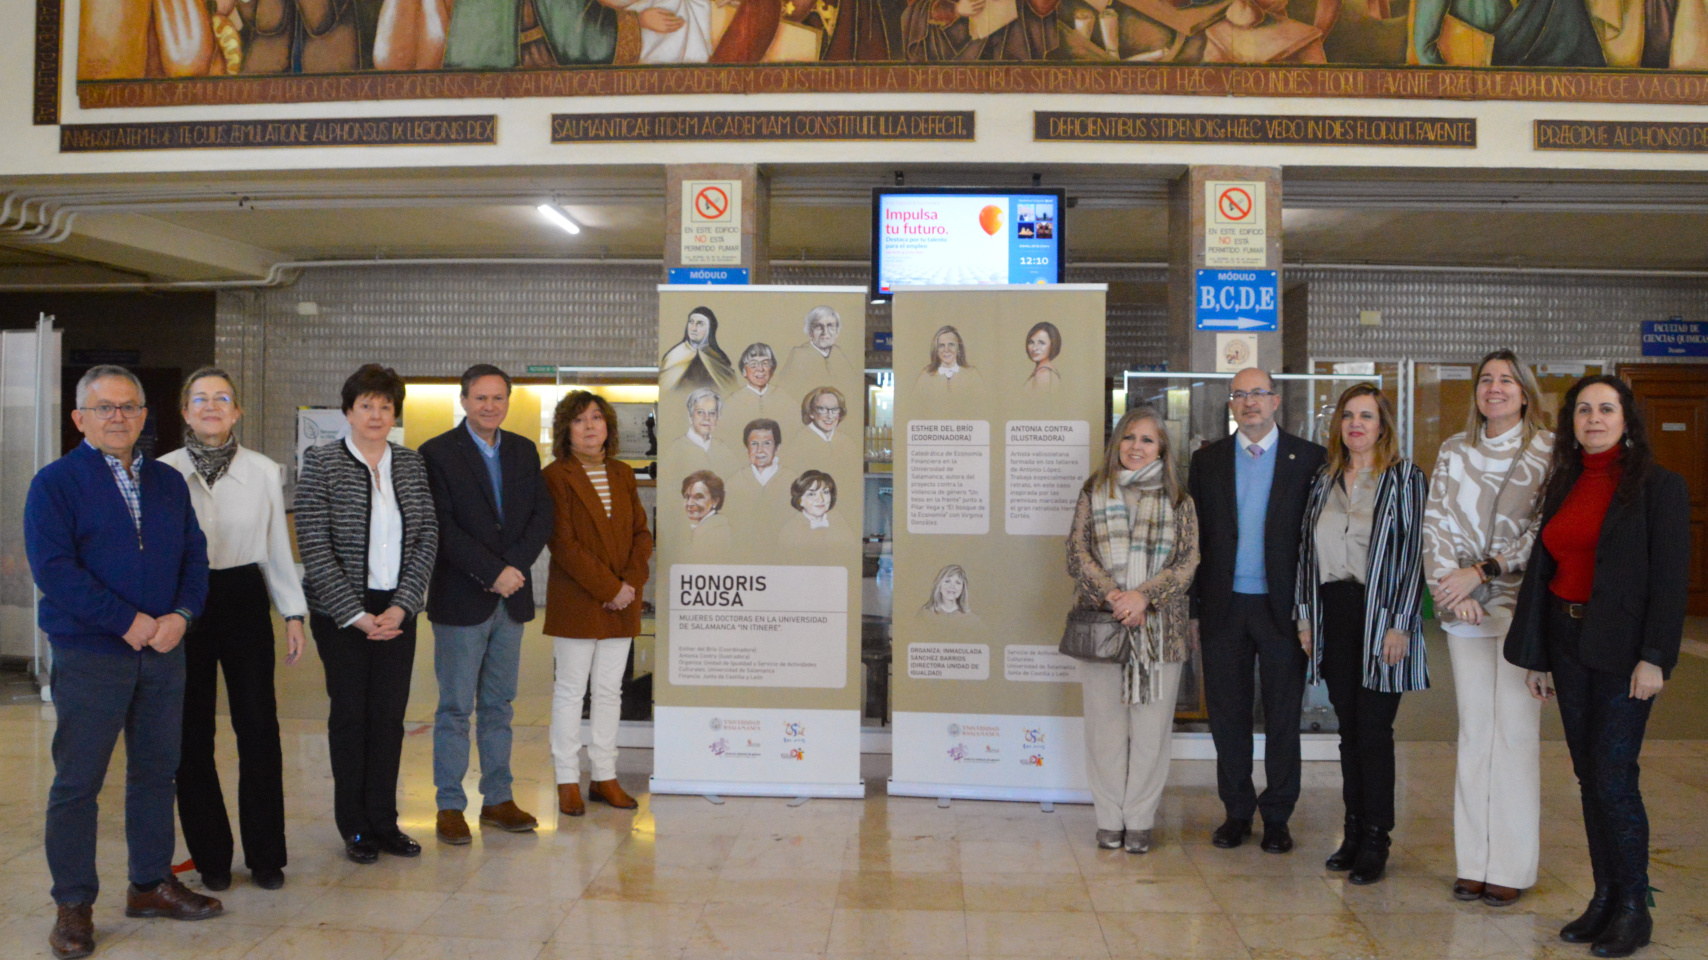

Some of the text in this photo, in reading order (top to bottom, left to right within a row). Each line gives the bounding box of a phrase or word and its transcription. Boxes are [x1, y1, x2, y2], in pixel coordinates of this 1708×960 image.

[701, 116, 790, 138] ACADEMIAM
[1050, 116, 1147, 138] DEFICIENTIBUS
[1265, 119, 1304, 139] VERO
[1614, 126, 1690, 148] ALPHONSO
[886, 208, 938, 224] Impulsa
[886, 223, 949, 235] tu futuro.
[694, 234, 707, 243] NO
[1219, 236, 1231, 245] NO
[1020, 257, 1049, 265] 12:10
[690, 270, 727, 279] MÓDULO
[1218, 272, 1256, 281] MÓDULO
[1200, 285, 1274, 313] B,C,D,E
[956, 424, 974, 432] BRÍO
[911, 434, 971, 442] (COORDINADORA)
[1010, 434, 1065, 442] (ILUSTRADORA)
[681, 575, 766, 592] HONORIS
[680, 591, 744, 607] CAUSA
[679, 614, 713, 622] MUJERES
[715, 614, 752, 622] DOCTORAS
[779, 616, 827, 624] UNIVERSIDAD
[690, 623, 736, 631] SALAMANCA
